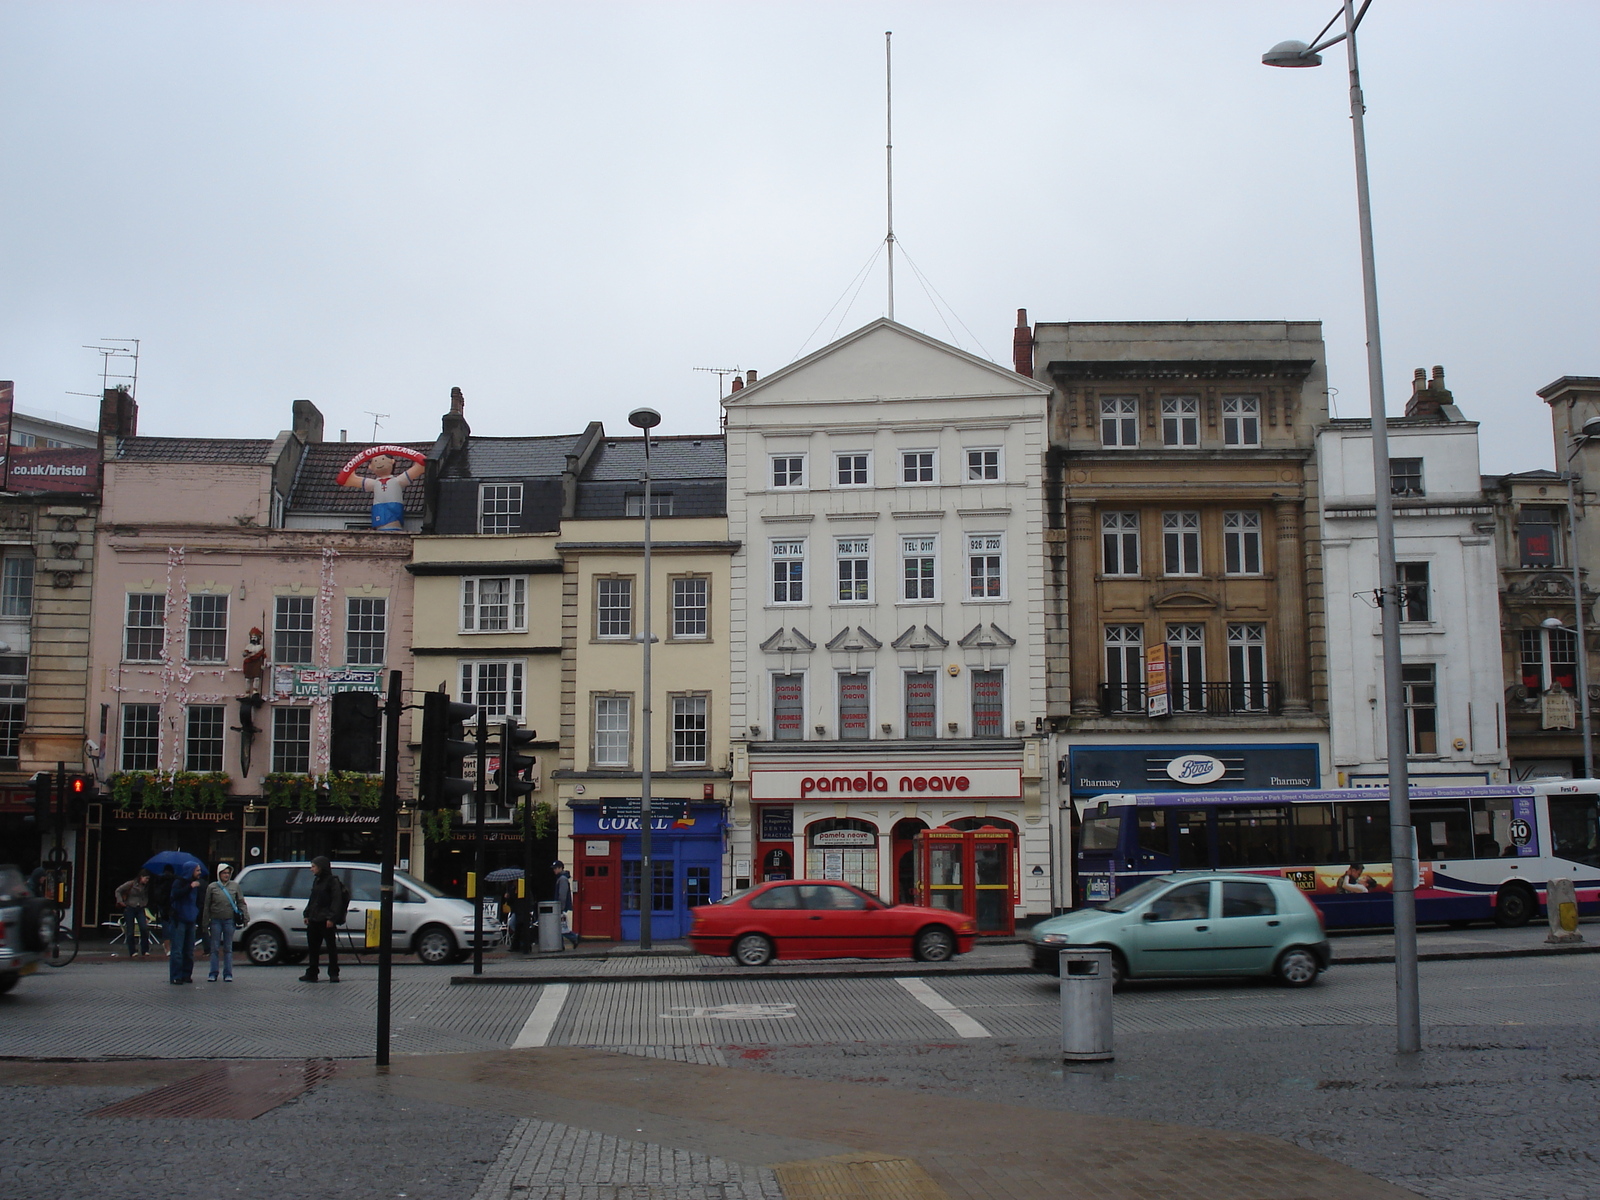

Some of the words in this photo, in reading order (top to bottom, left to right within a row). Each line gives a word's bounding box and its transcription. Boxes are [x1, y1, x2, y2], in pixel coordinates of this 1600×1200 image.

[343, 452, 365, 472] COME
[365, 447, 378, 456] ON
[10, 464, 87, 476] .co.uk/bristol
[904, 542, 918, 551] TEL:
[920, 541, 934, 551] 0117
[970, 540, 983, 550] 926
[986, 539, 1000, 549] 2720
[775, 683, 802, 693] pamela
[841, 682, 868, 692] pamela
[907, 681, 934, 691] pamela
[974, 679, 1001, 689] pamela
[295, 685, 318, 695] LIVE
[907, 711, 935, 719] BUSINESS
[975, 710, 1002, 718] BUSINESS
[778, 722, 800, 730] CENTRE
[844, 721, 866, 729] CENTRE
[911, 719, 932, 727] CENTRE
[977, 718, 999, 727] CENTRE
[1178, 759, 1214, 783] Boots
[800, 771, 888, 799] pamela
[899, 776, 970, 792] neave
[1080, 778, 1121, 792] Pharmacy
[1270, 776, 1310, 790] Pharmacy
[1470, 788, 1488, 797] Temple
[1181, 795, 1201, 804] Temple
[113, 809, 134, 819] The
[137, 809, 168, 820] Horn
[169, 810, 182, 821] &
[184, 810, 234, 823] Trumpet
[336, 811, 380, 824] welcome
[598, 818, 668, 830] CORL
[819, 832, 845, 840] pamela
[1511, 824, 1528, 838] 10
[773, 850, 784, 858] 18
